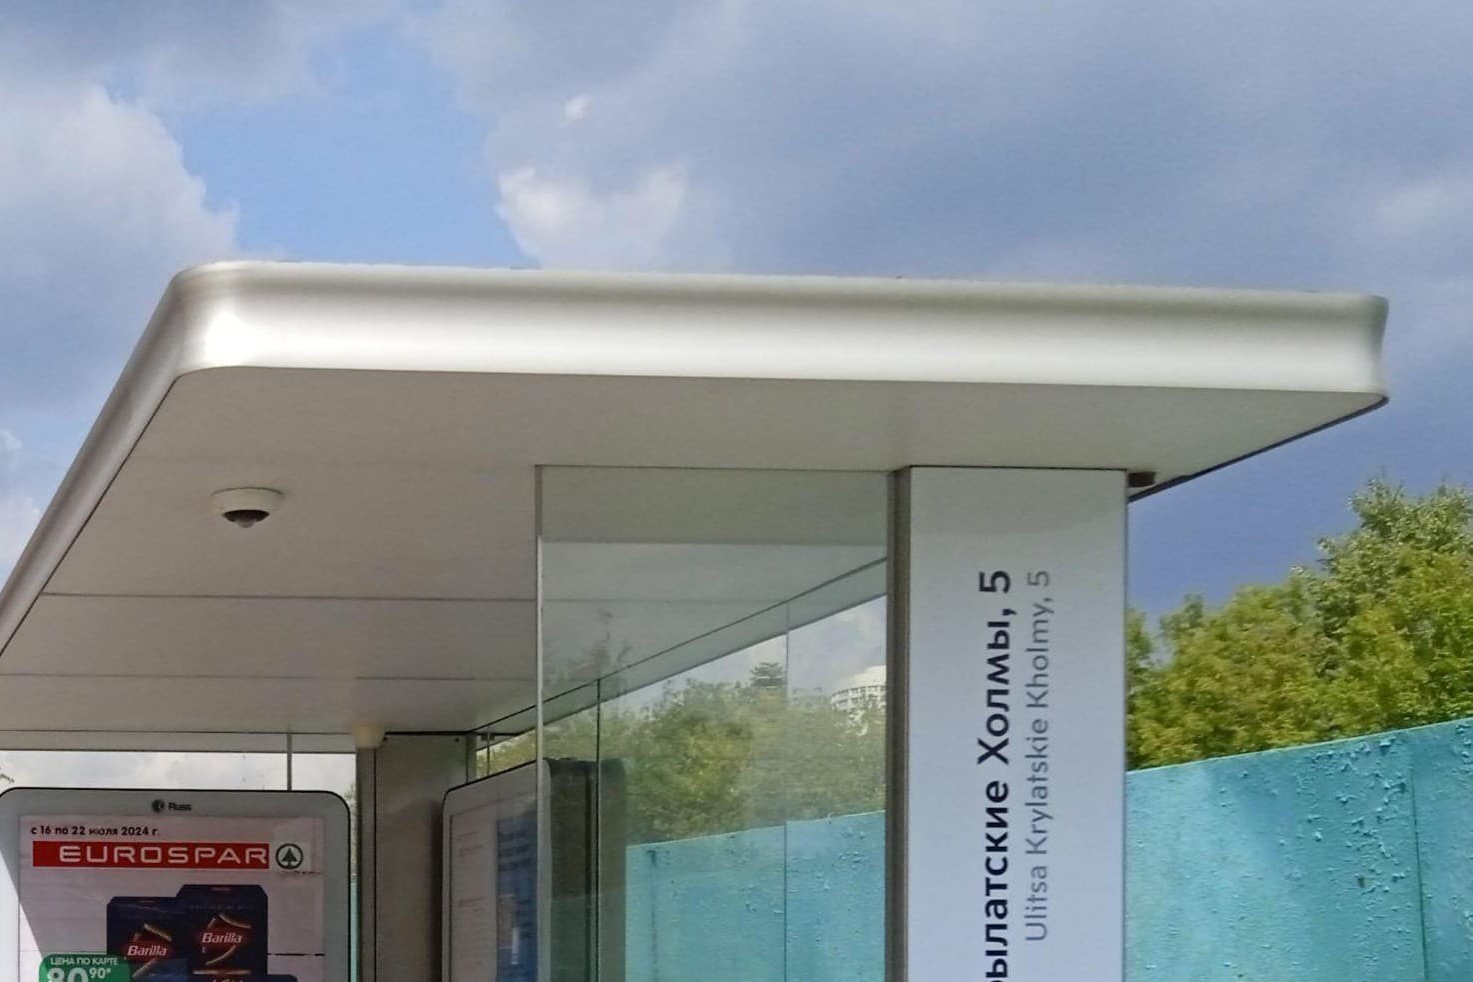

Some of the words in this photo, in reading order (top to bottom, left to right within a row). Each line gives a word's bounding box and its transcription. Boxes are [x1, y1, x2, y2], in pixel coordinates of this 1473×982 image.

[979, 570, 1011, 594] 5
[1027, 571, 1050, 587] 5
[1024, 597, 1055, 708] Kholmy,
[976, 608, 1017, 766] Холмы,
[1024, 718, 1054, 855] Krylatskie
[41, 825, 52, 835] 16
[55, 827, 69, 835] по
[72, 826, 86, 836] 22
[89, 828, 118, 836] июля
[121, 826, 149, 836] 2024
[59, 845, 267, 865] EUROSPAR
[1024, 866, 1048, 941] Ulitsa
[202, 932, 243, 944] Barilla
[127, 945, 167, 956] Barilla
[50, 957, 75, 966] ЦЕНА
[77, 957, 90, 965] ПО
[92, 957, 118, 965] КАРТЕ
